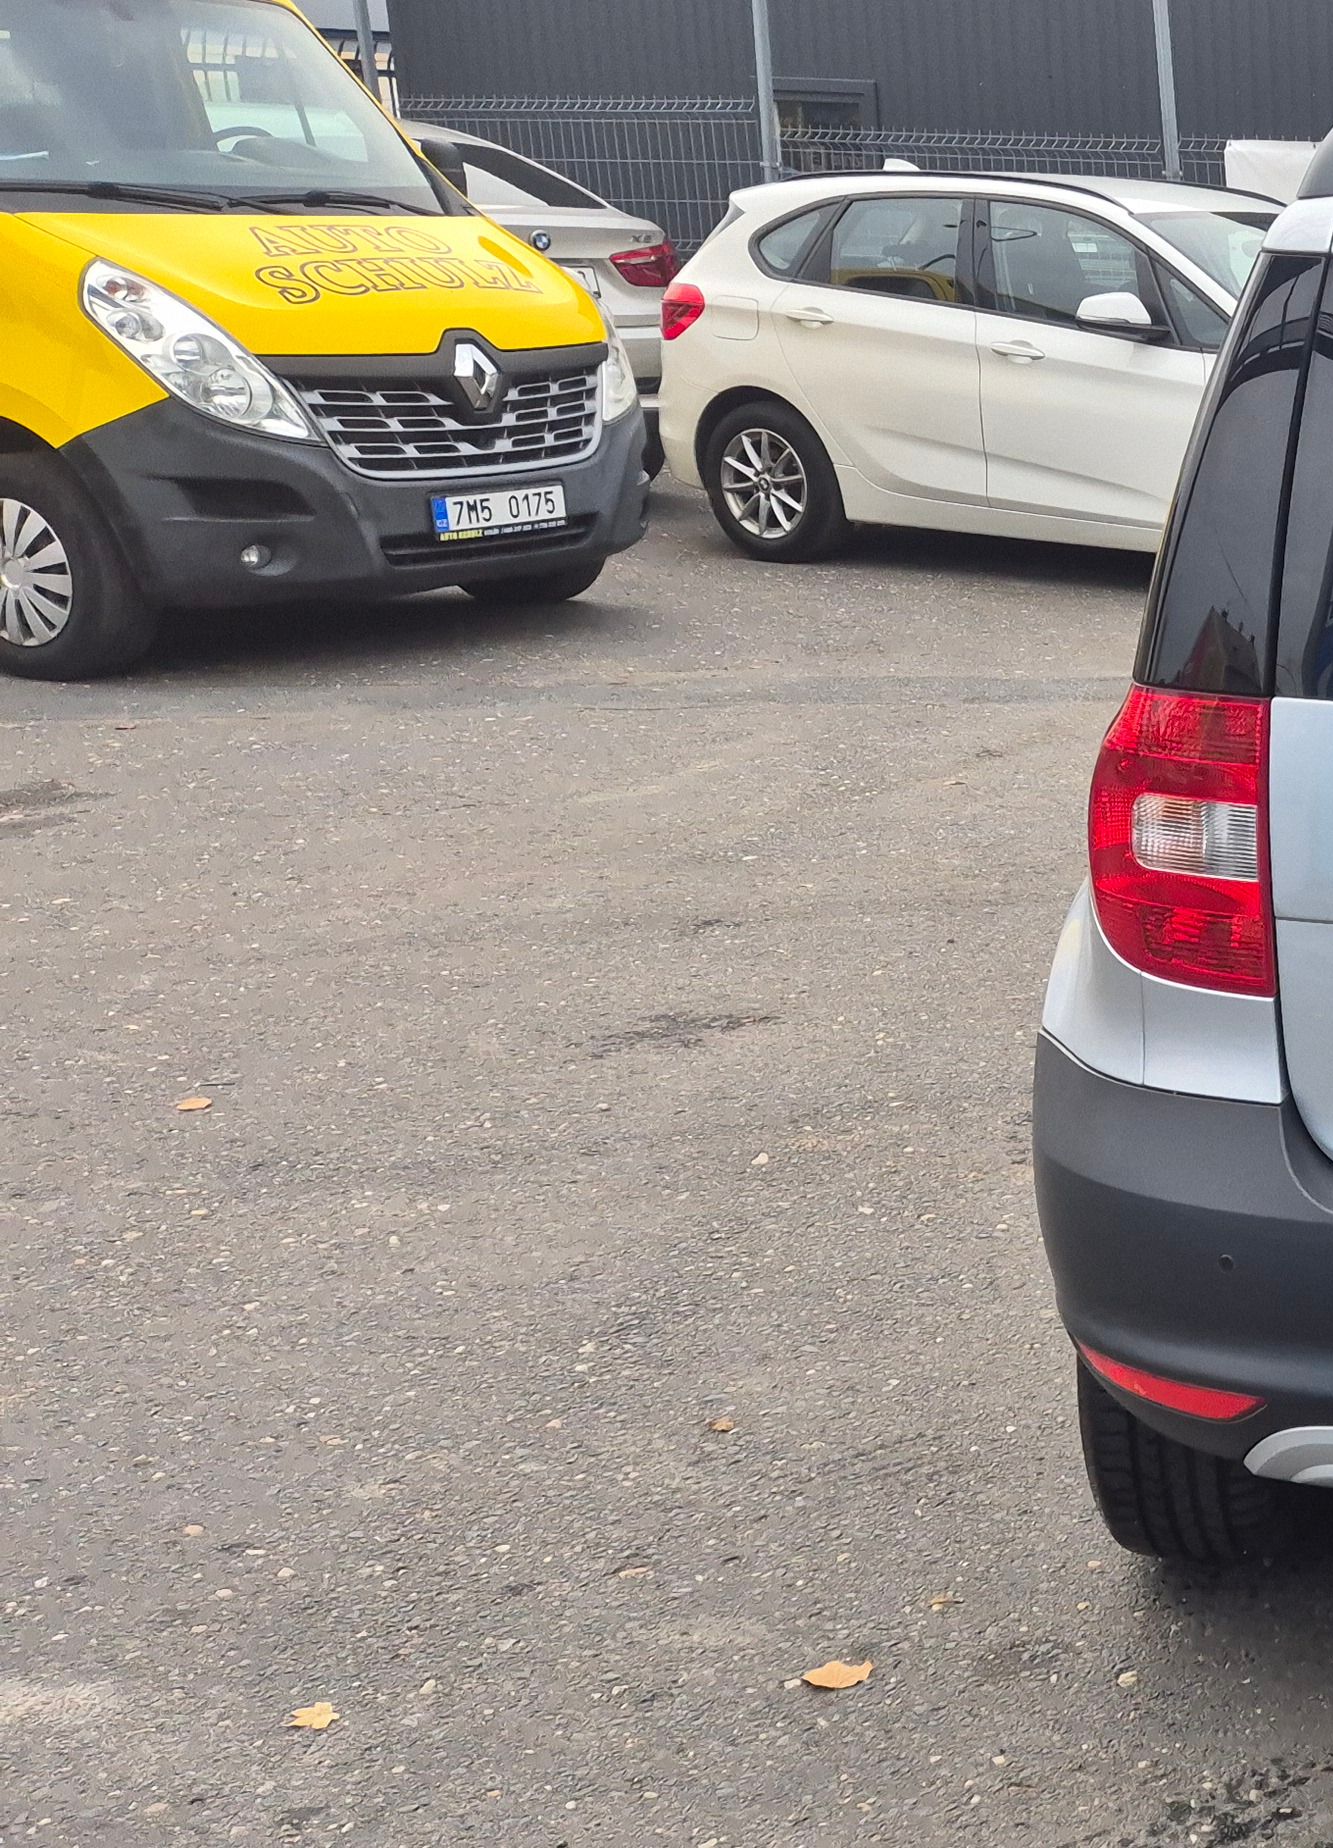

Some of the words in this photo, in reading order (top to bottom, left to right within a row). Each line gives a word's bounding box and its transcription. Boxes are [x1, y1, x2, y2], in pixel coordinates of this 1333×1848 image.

[250, 224, 452, 258] AUTO
[255, 257, 543, 304] SCHULZ
[453, 497, 492, 526] 7M5
[508, 490, 556, 519] 0175
